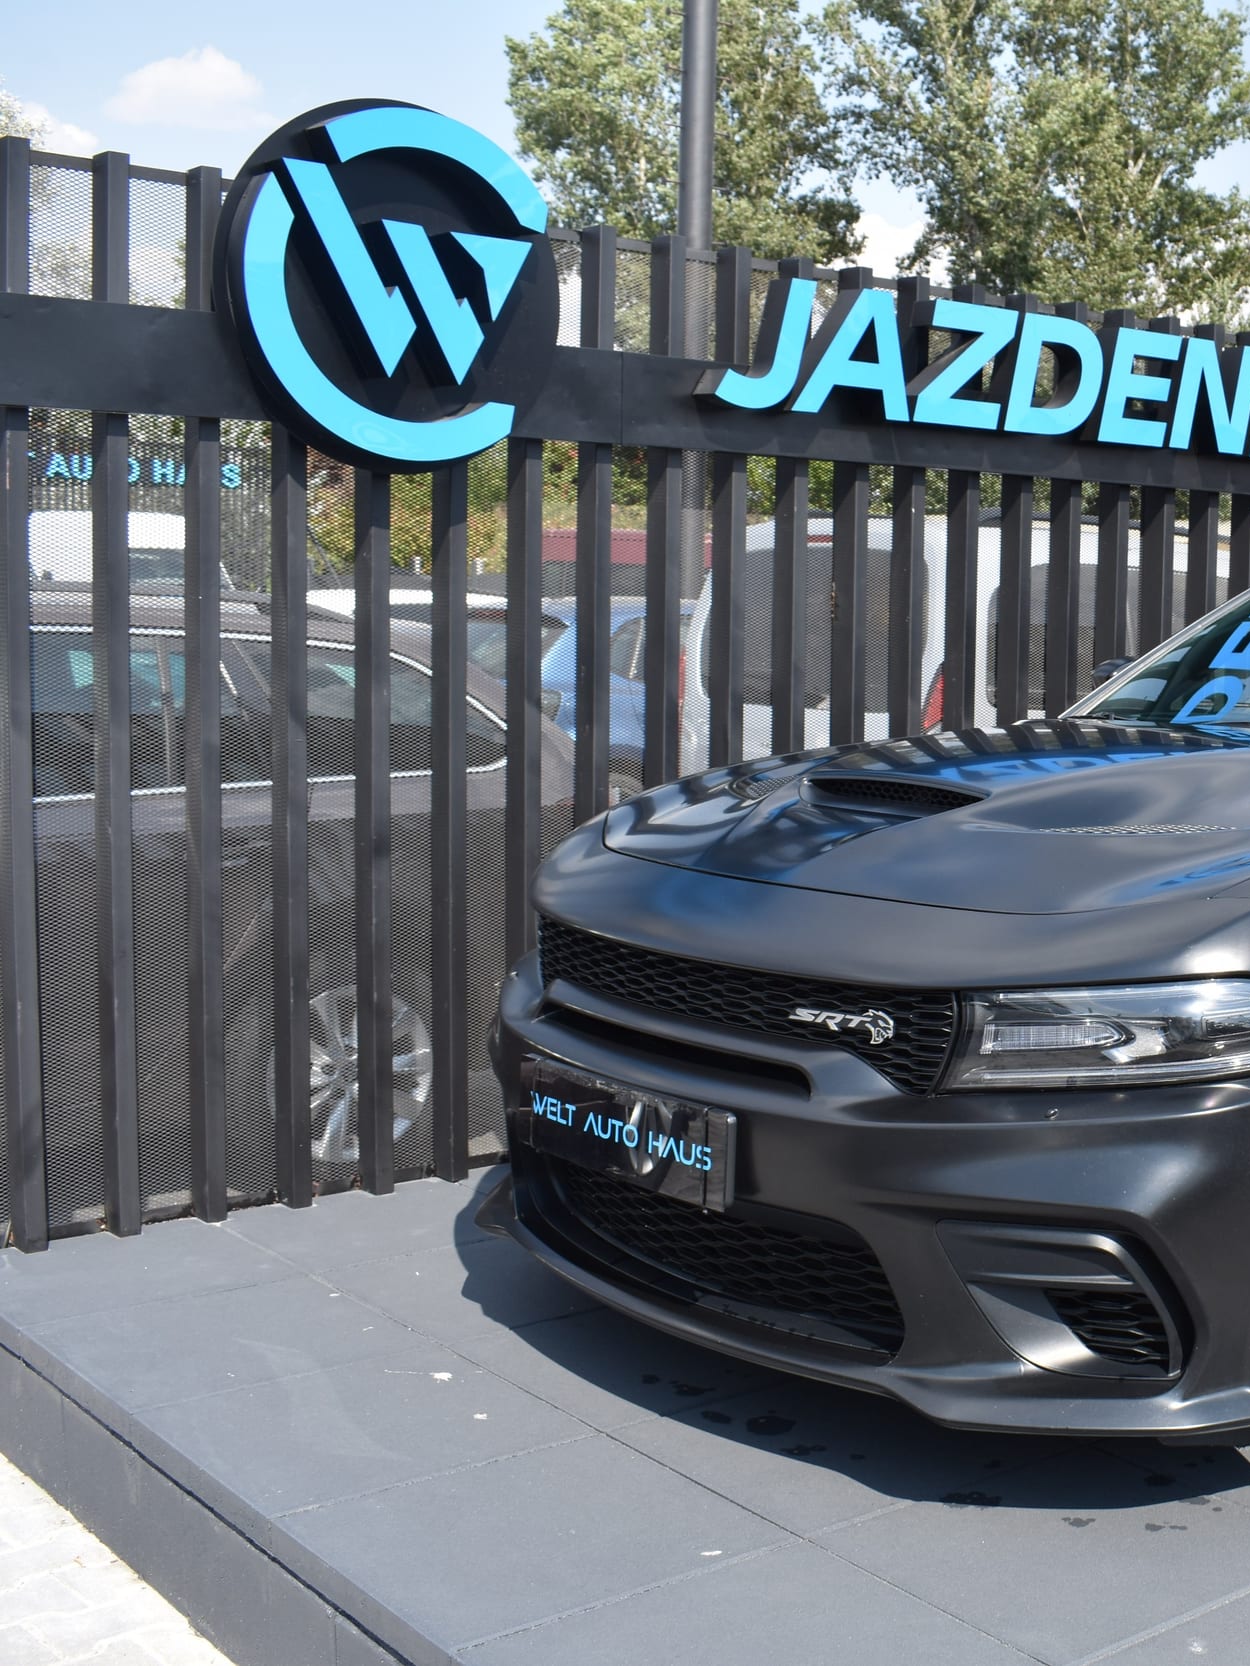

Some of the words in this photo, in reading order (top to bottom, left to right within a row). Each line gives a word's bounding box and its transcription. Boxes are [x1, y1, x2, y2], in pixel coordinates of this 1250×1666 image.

[46, 452, 141, 484] AUO
[151, 458, 242, 489] HS
[788, 1008, 873, 1031] SRT
[531, 1090, 577, 1127] WELT
[583, 1111, 640, 1149] AUTO
[647, 1130, 713, 1172] HAUS
